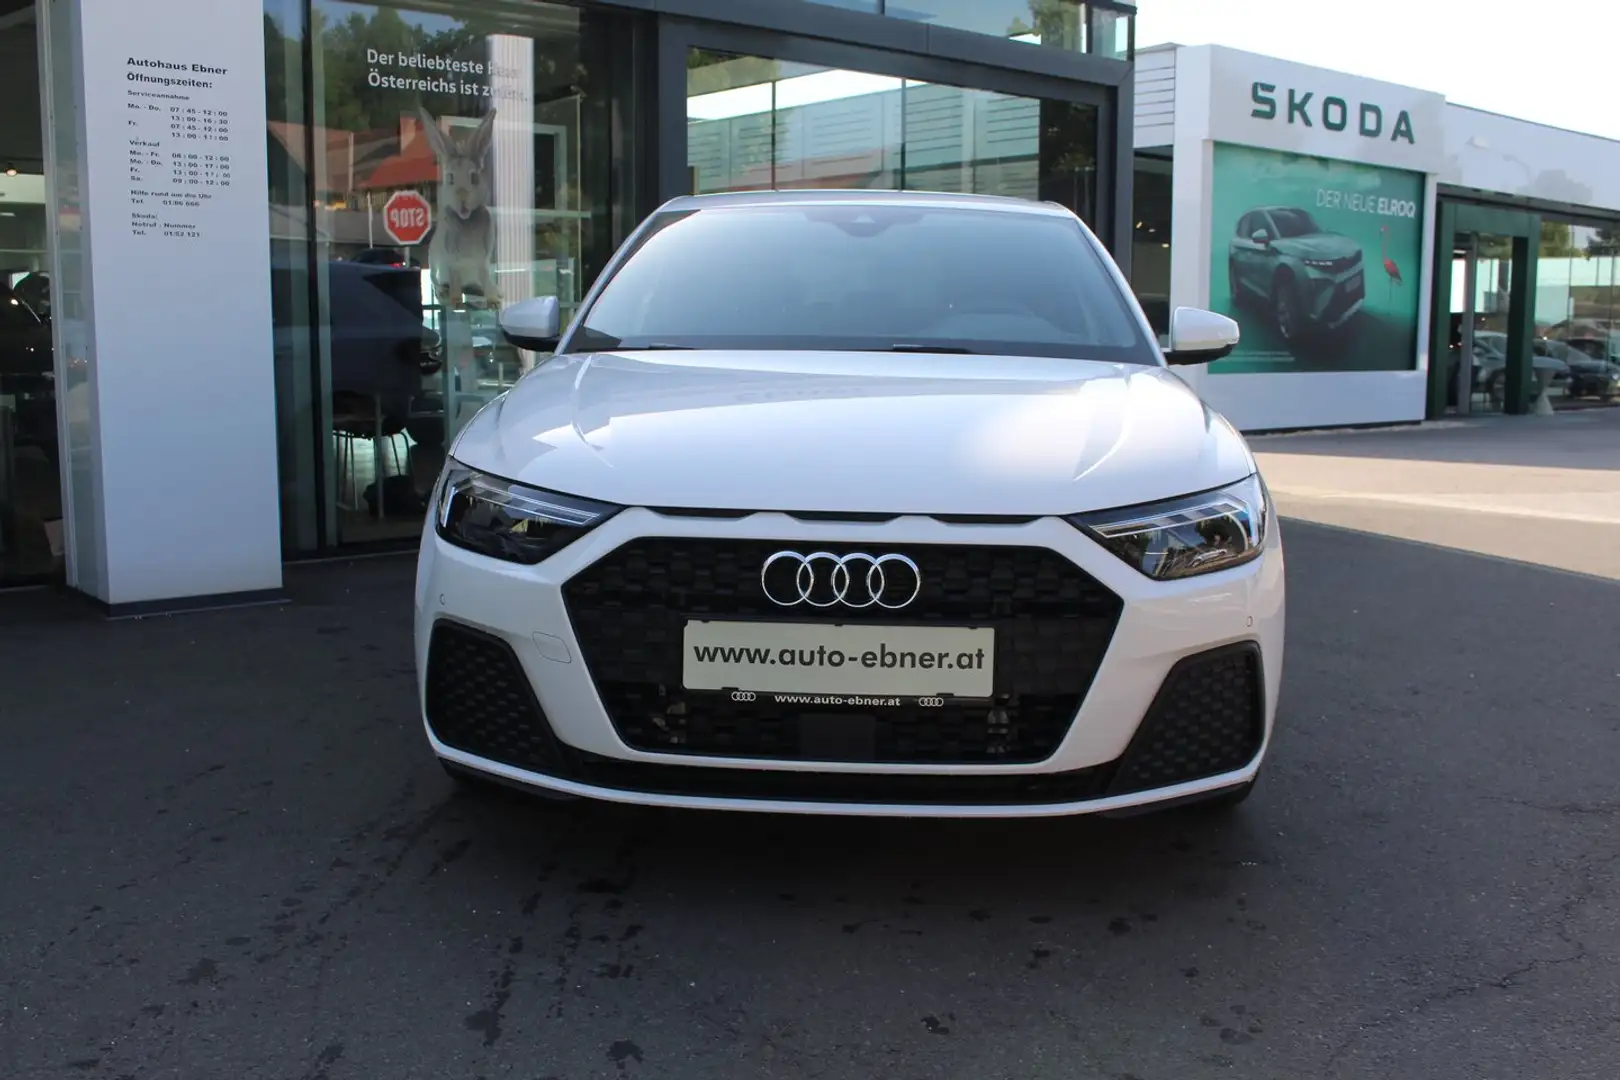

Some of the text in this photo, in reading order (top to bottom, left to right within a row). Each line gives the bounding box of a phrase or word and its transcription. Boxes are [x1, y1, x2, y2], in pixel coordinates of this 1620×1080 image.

[126, 57, 228, 75] Autohaus Ebner
[366, 48, 394, 66] Der
[398, 52, 484, 75] beliebteste
[126, 72, 213, 89] Öffnungszeiten:
[368, 68, 456, 94] Österreichs
[460, 80, 479, 96] ist
[128, 90, 190, 100] Serviceannahme
[129, 140, 160, 148] Verkauf
[1316, 188, 1416, 220] DER NEUE ELROQ
[694, 643, 986, 670] www.auto-ebner.at
[774, 693, 900, 707] www.auto-ebner.at
